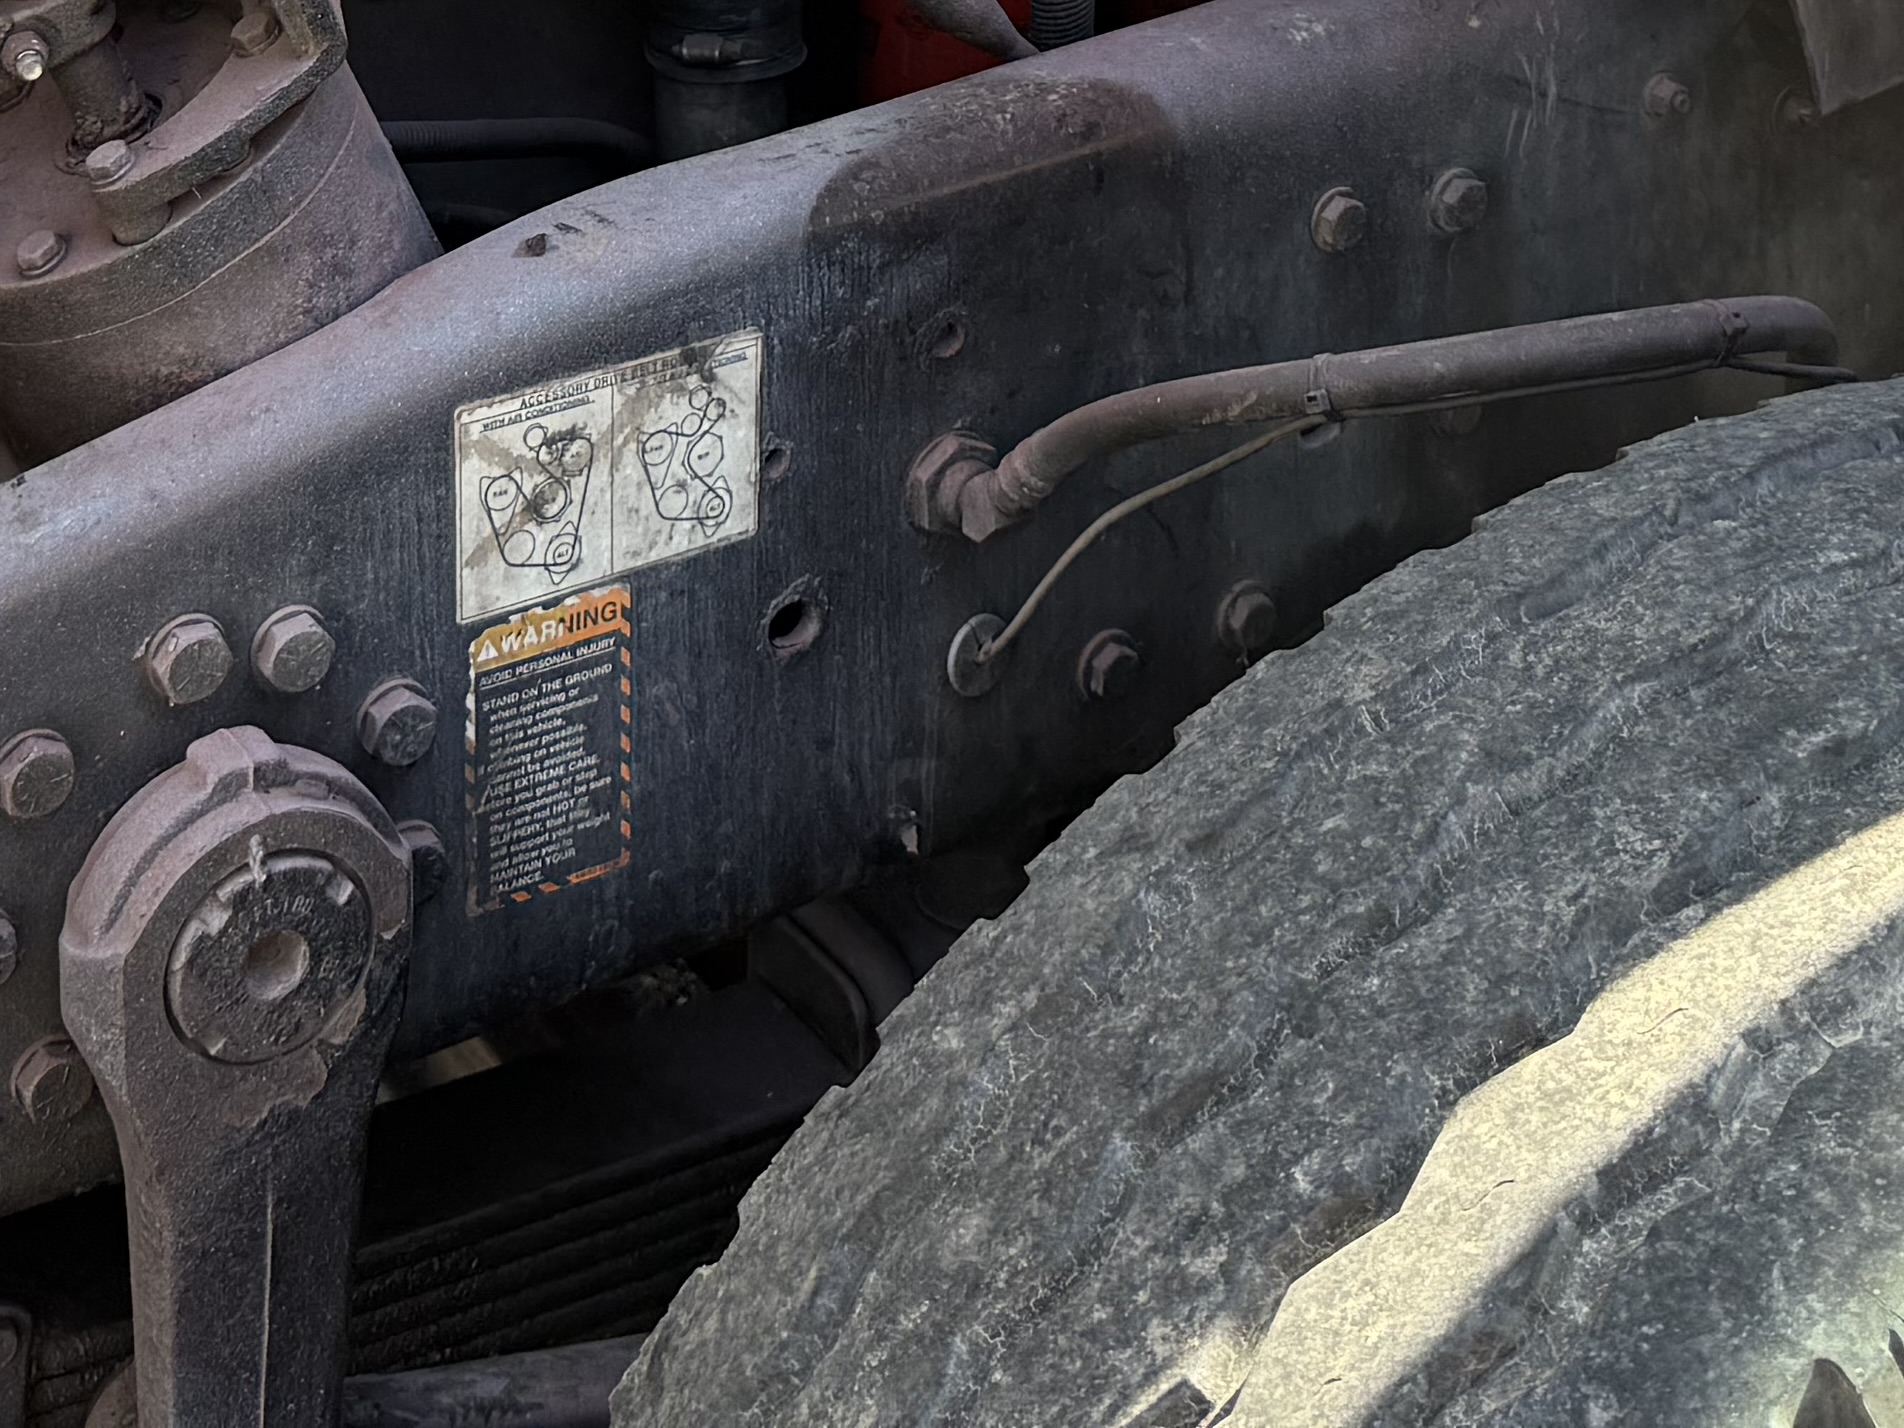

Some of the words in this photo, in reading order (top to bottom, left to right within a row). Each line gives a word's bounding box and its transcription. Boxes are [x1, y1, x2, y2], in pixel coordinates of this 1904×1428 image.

[500, 600, 617, 654] WARNING
[479, 669, 512, 686] AVOID
[516, 651, 573, 675] PERSONAL
[576, 637, 615, 655] INJURY
[482, 692, 518, 711] STAND
[541, 677, 562, 693] THE
[565, 663, 612, 685] GROUND
[514, 766, 565, 789] EXTREME
[552, 798, 575, 813] HOT
[544, 849, 575, 864] YOUR
